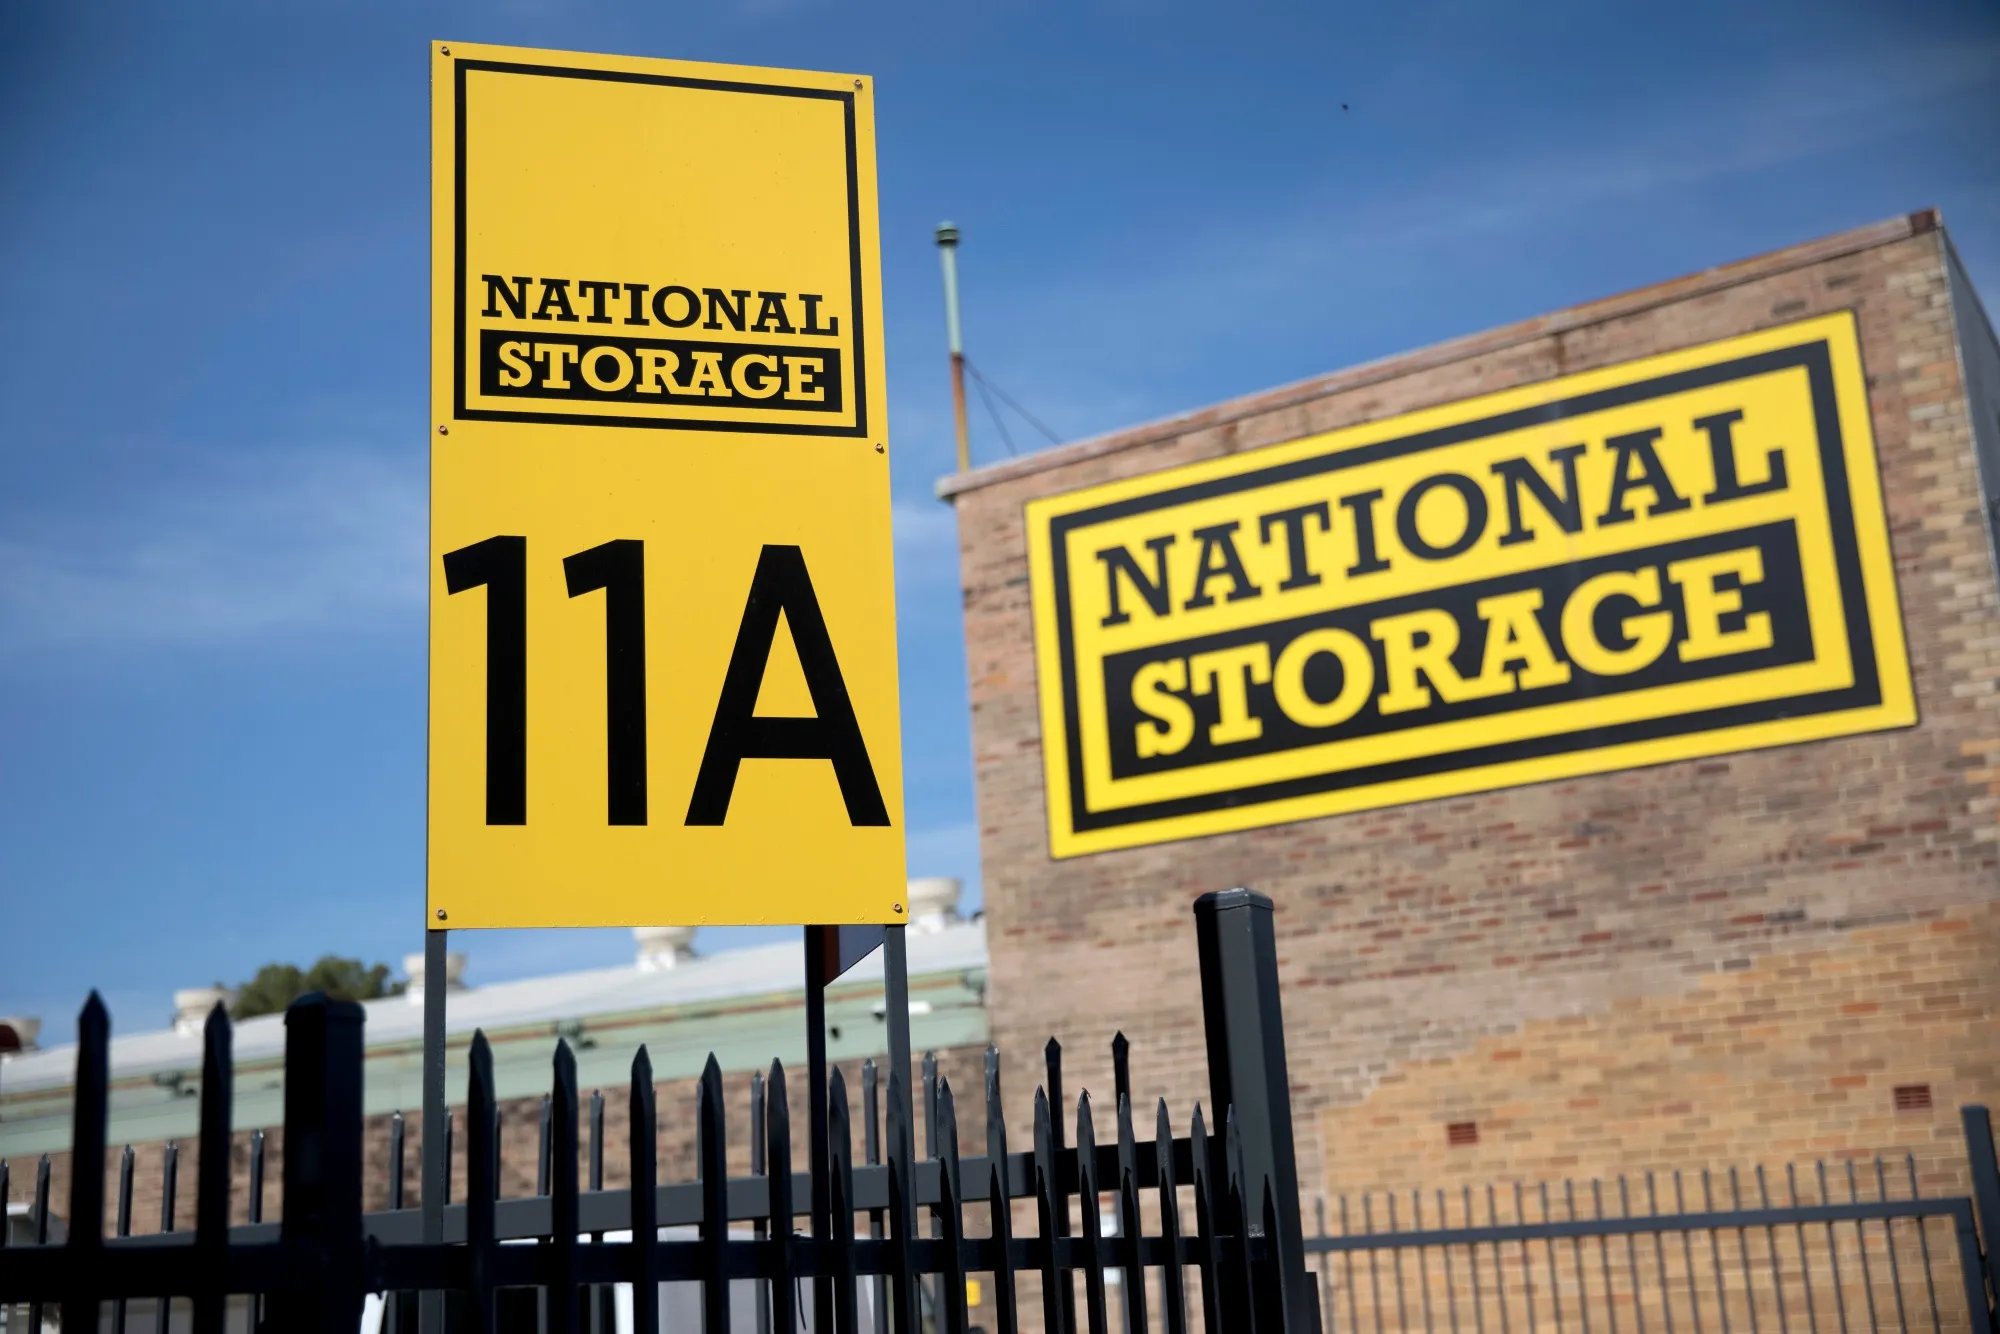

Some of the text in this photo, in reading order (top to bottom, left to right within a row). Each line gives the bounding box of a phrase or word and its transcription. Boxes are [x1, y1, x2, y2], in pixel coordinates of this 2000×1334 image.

[481, 274, 839, 337] NATIONAL
[498, 340, 825, 402] STORAGE
[1095, 408, 1790, 629] NATIONAL
[442, 534, 892, 827] 11A
[1130, 544, 1775, 759] STORAGE
